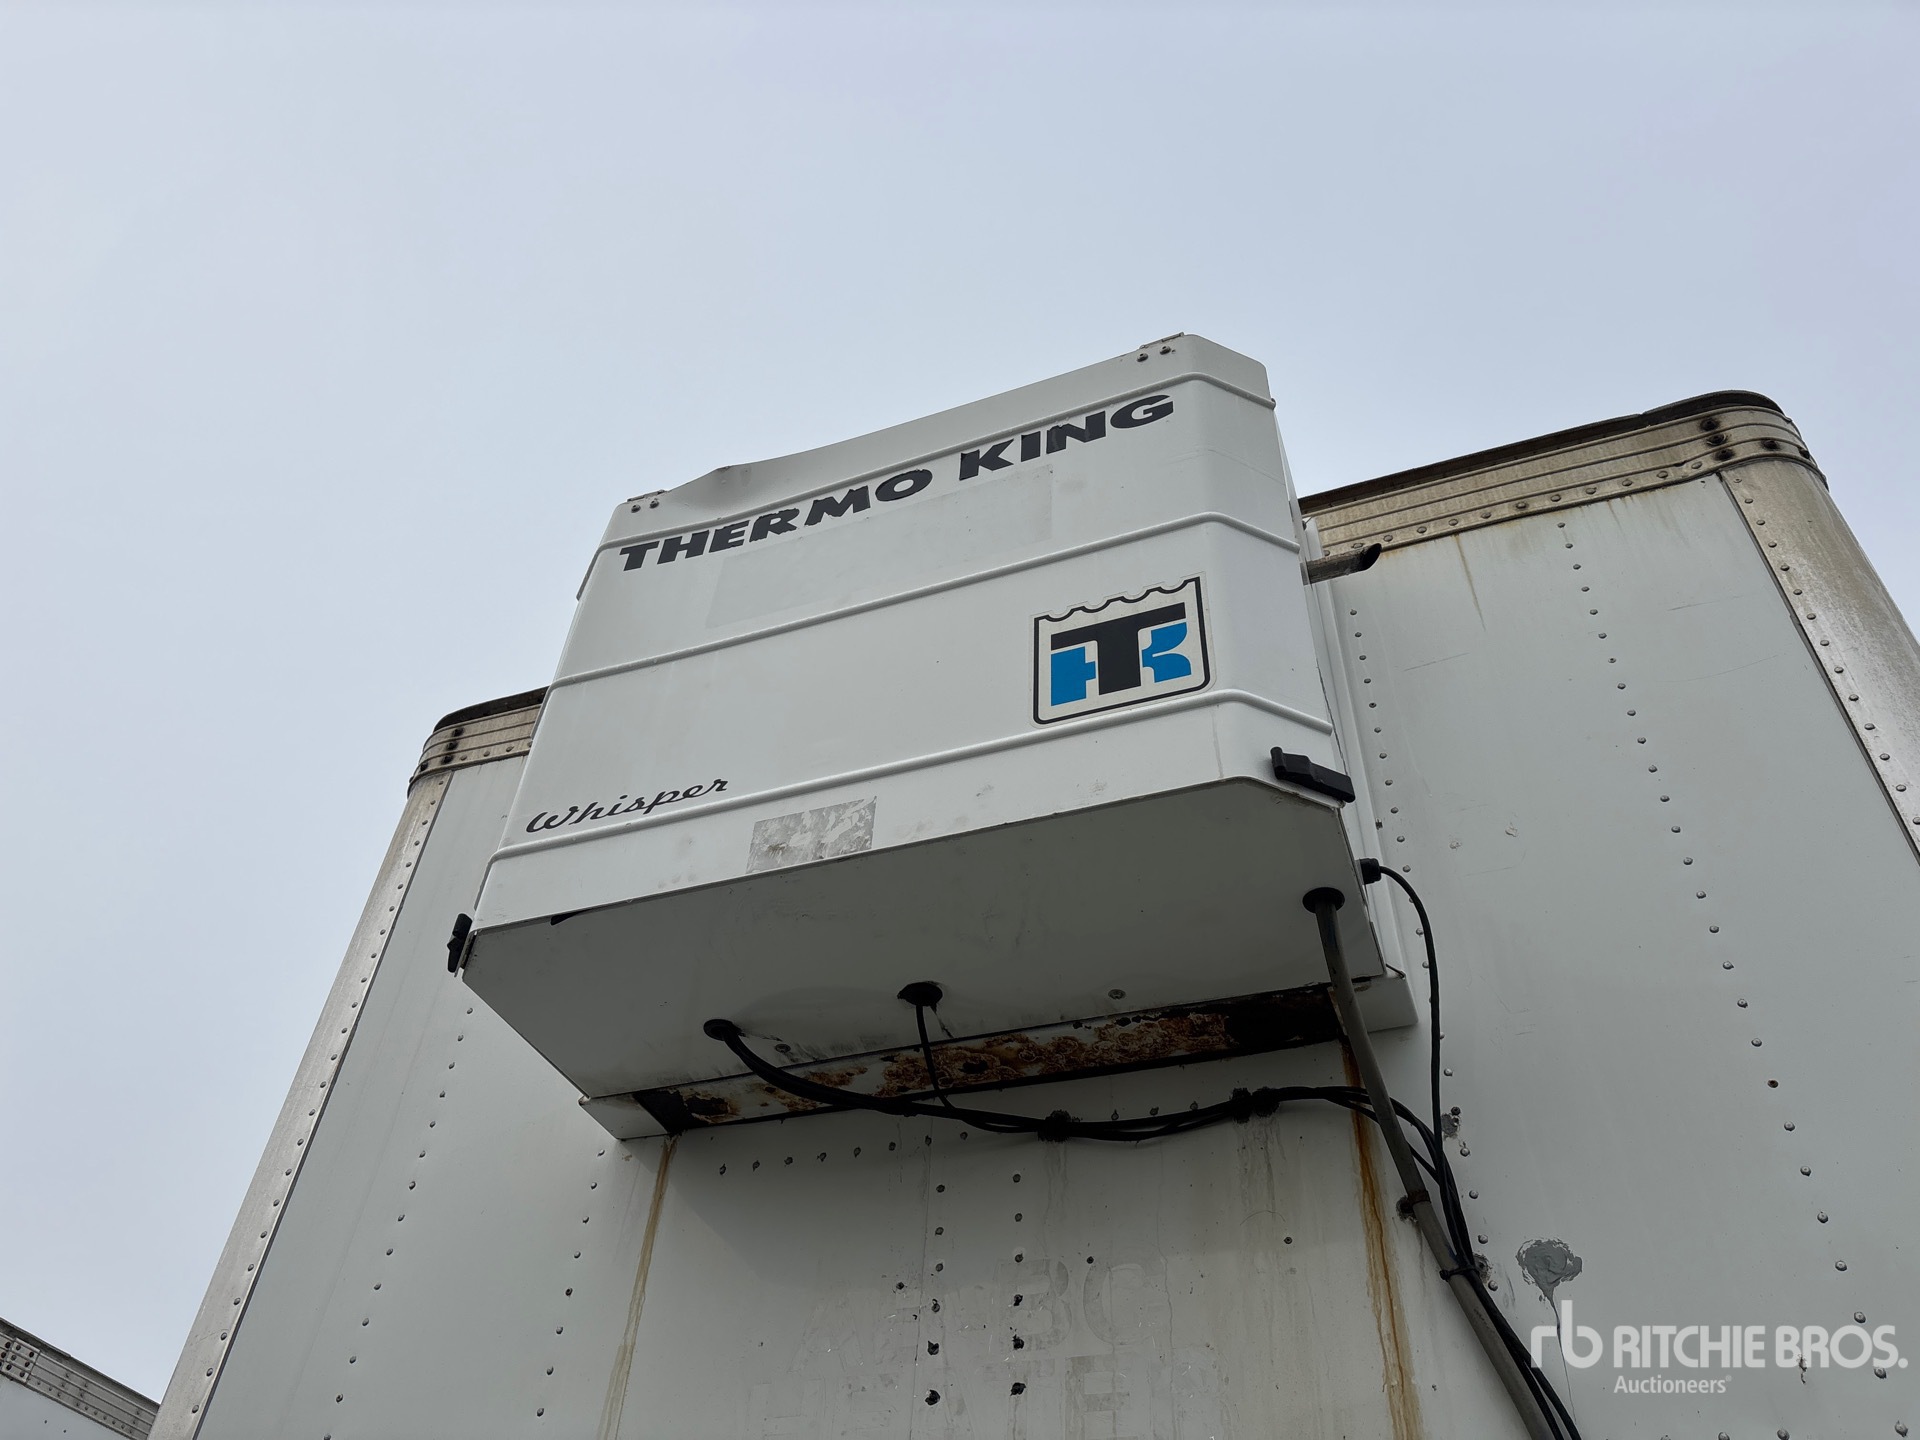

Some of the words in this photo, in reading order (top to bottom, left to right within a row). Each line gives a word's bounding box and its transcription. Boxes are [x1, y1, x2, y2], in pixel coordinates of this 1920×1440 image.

[620, 469, 933, 571] THERMO
[959, 394, 1173, 481] KING
[526, 778, 728, 834] Whisper
